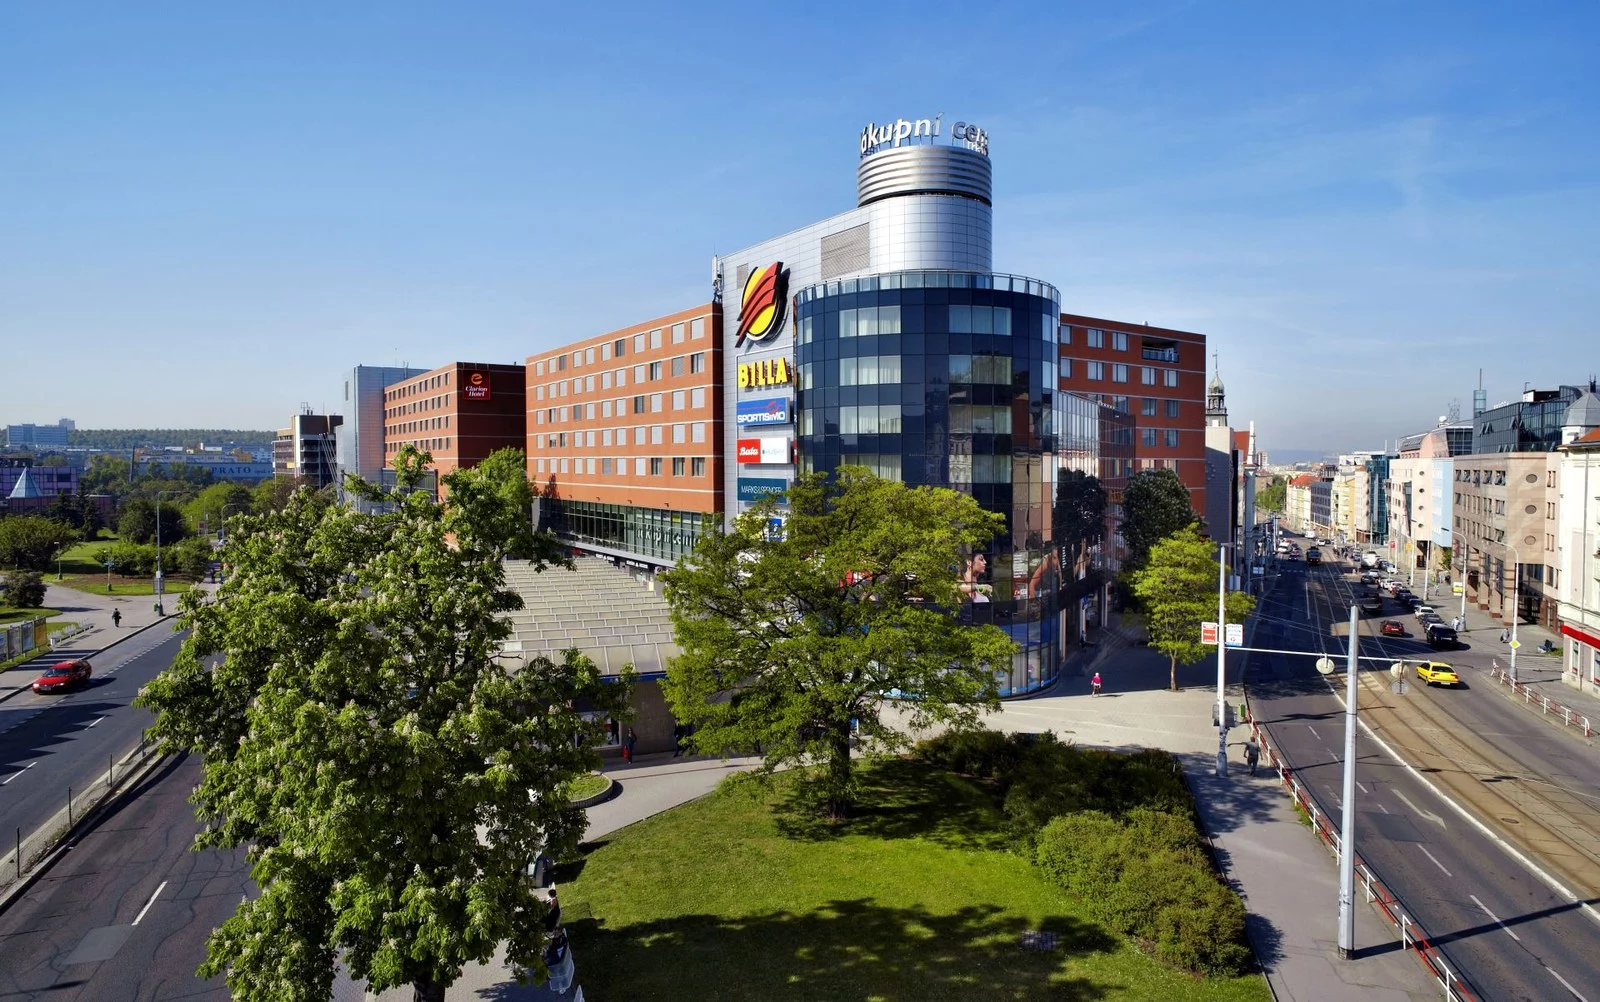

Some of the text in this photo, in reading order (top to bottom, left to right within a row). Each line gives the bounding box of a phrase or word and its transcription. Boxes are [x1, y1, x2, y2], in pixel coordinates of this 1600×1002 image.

[738, 357, 790, 389] BILLA
[737, 411, 786, 423] SPORTISIMO
[211, 466, 251, 474] PRATO
